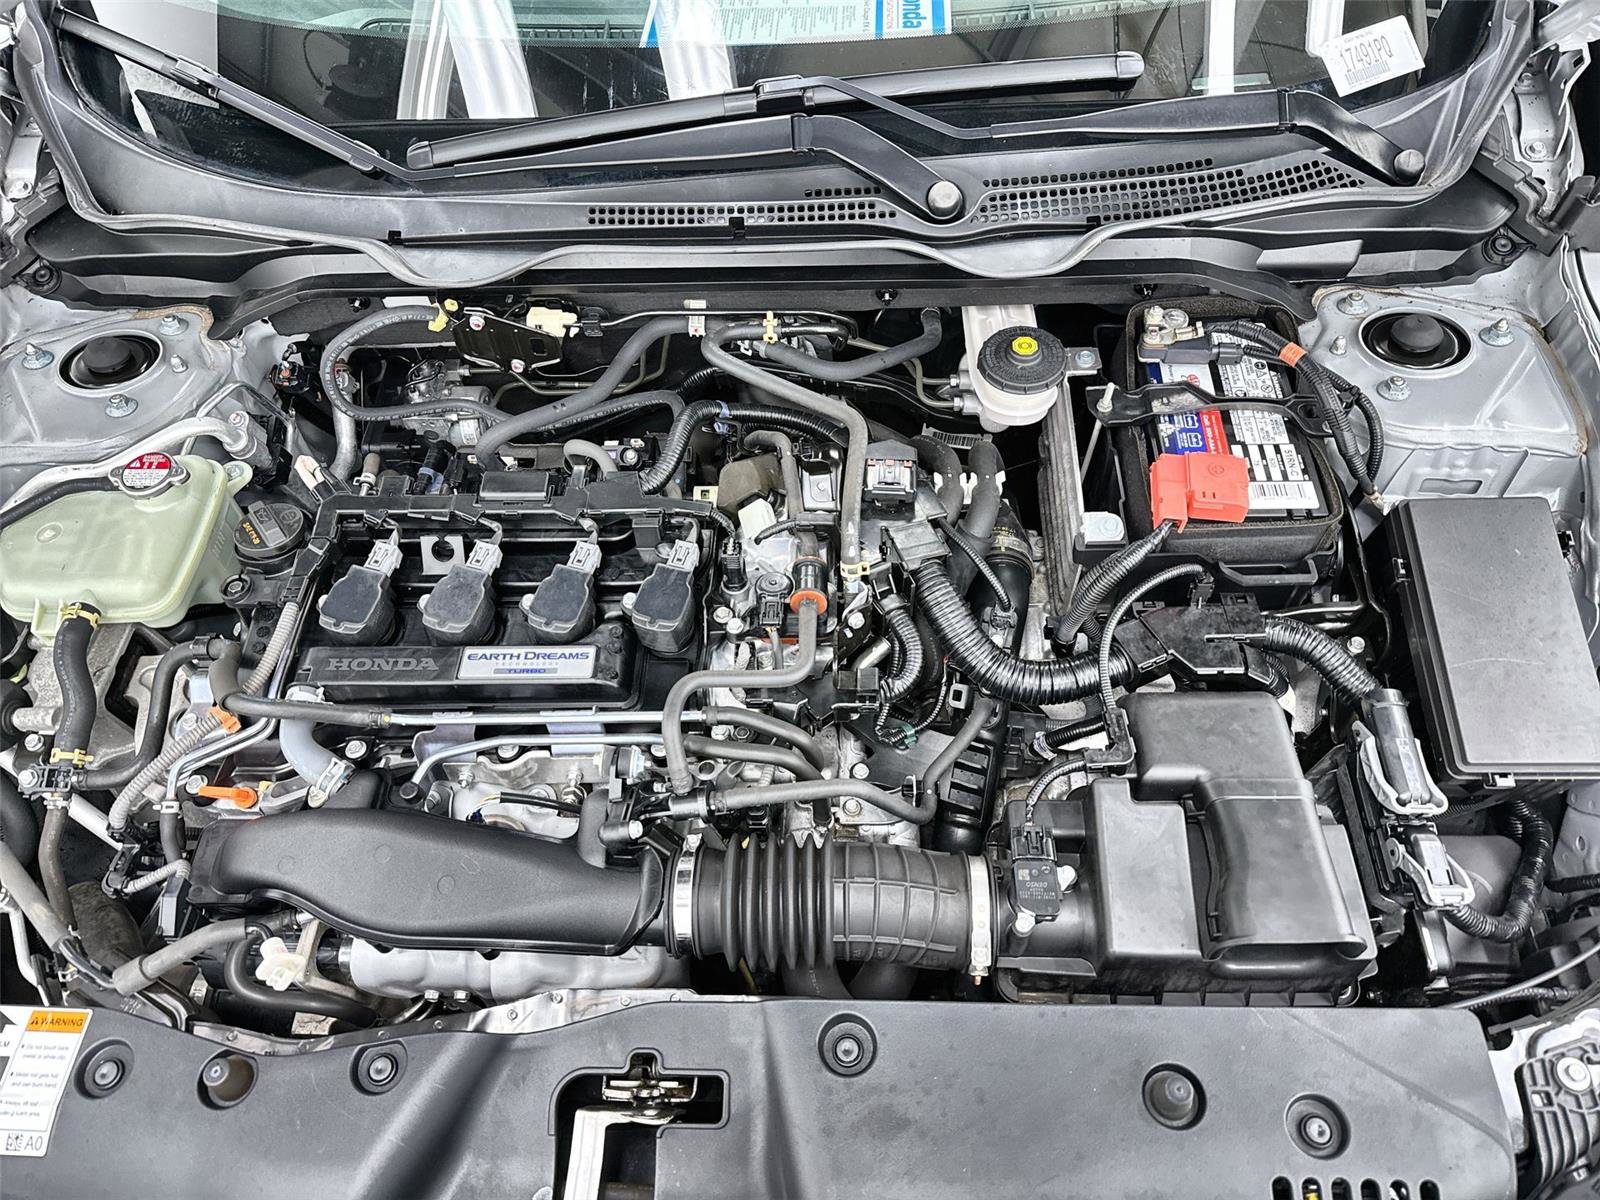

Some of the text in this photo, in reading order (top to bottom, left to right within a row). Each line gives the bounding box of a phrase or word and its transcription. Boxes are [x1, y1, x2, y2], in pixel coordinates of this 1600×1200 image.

[1340, 35, 1394, 73] 17491PQ
[1284, 449, 1300, 476] 51RN-C
[467, 650, 590, 661] EARTH DREAMS
[325, 657, 440, 672] HONDA
[41, 1018, 84, 1027] WARNING
